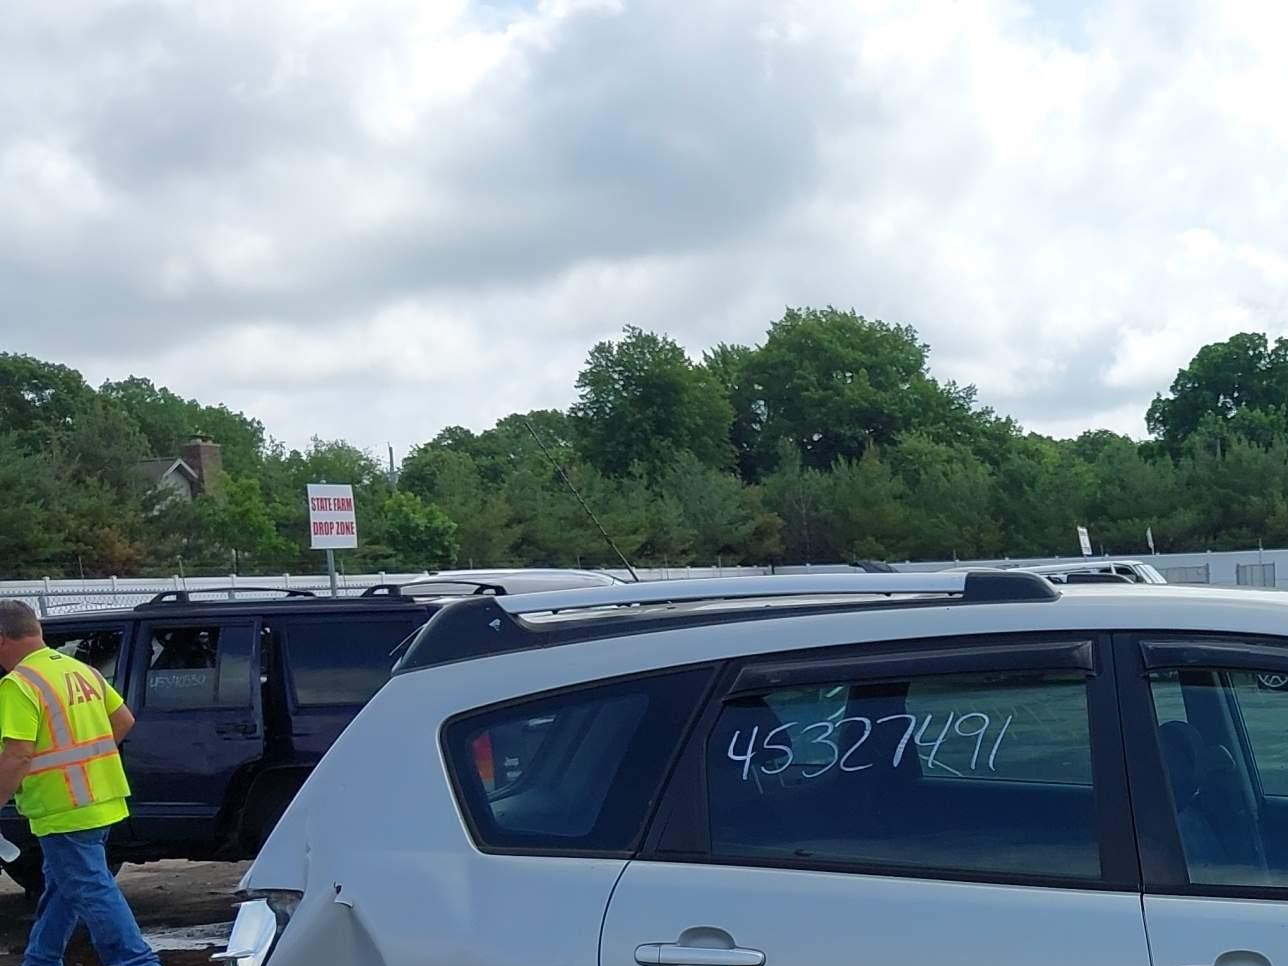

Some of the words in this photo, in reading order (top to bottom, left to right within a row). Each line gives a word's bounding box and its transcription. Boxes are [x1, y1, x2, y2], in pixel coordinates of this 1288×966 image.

[311, 497, 332, 512] STATE
[333, 497, 353, 512] FARM
[312, 521, 334, 536] DROP
[335, 521, 355, 536] ZONE
[727, 711, 1013, 780] 45327491
